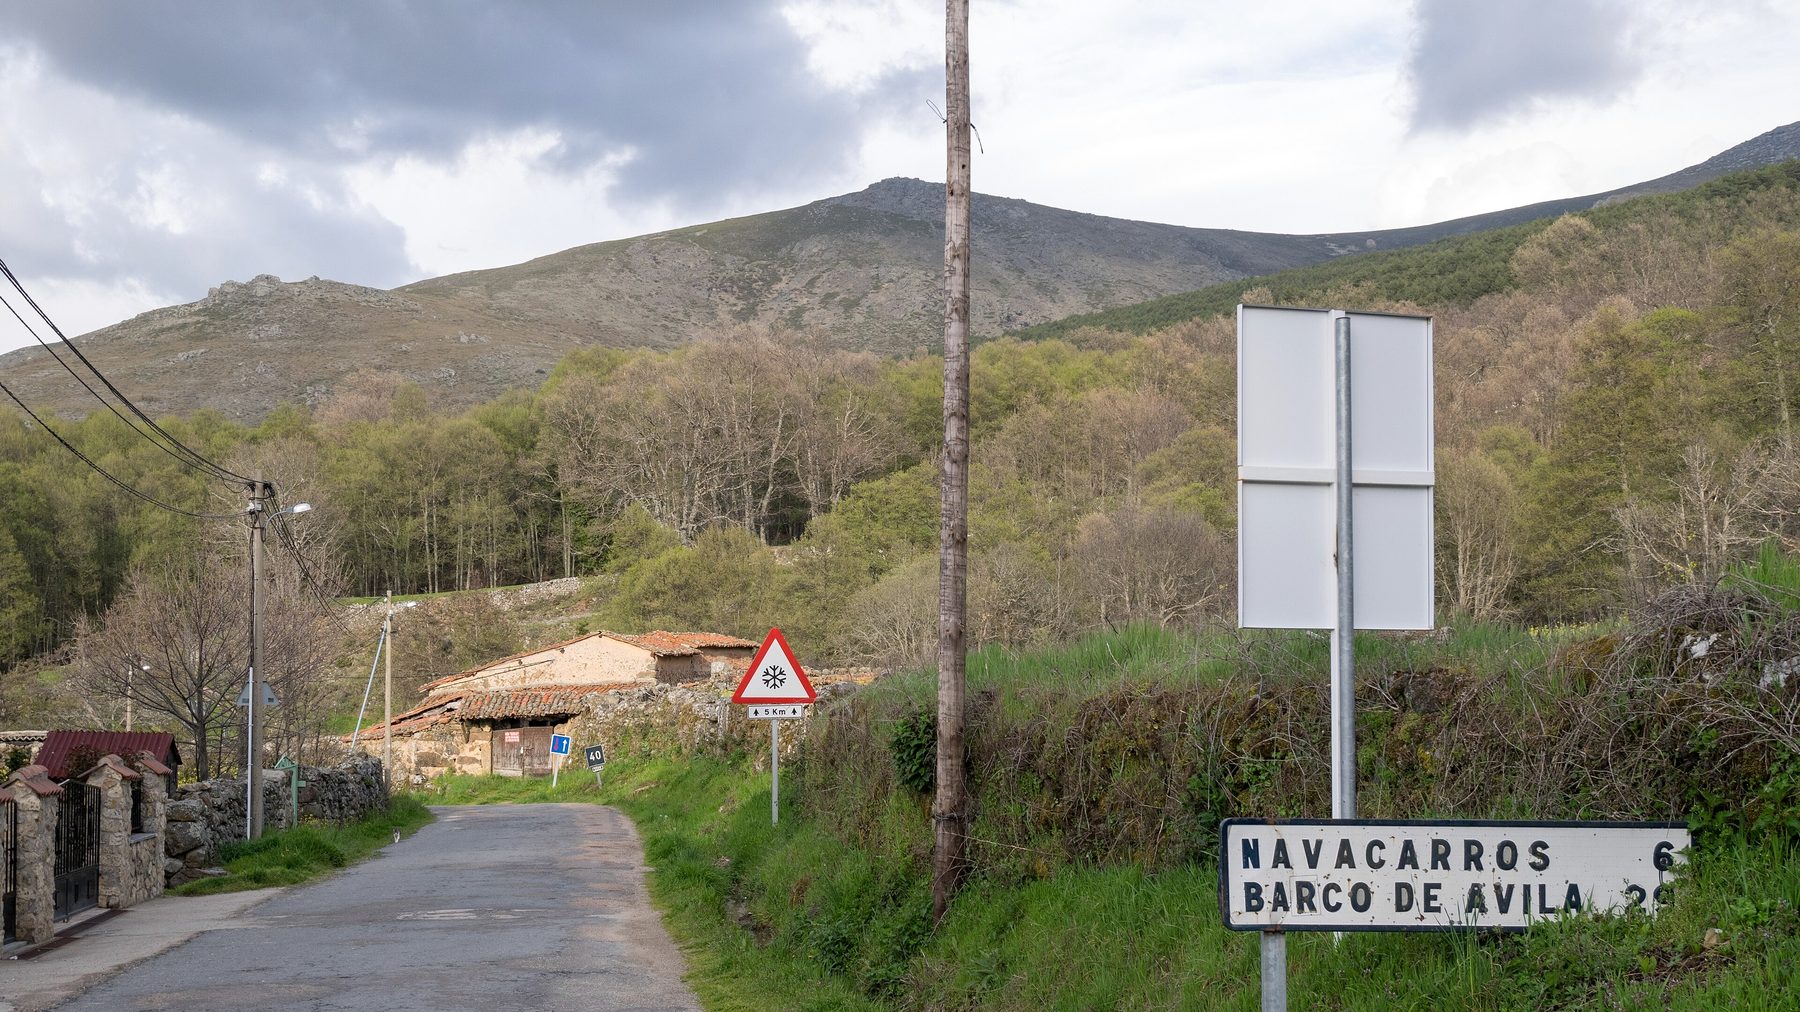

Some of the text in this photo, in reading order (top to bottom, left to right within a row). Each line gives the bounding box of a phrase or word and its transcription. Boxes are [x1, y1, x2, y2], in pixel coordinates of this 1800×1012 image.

[764, 708, 786, 716] 5 Km
[589, 750, 602, 762] 40
[1241, 838, 1675, 872] NAVACARROS 6
[1243, 881, 1372, 914] BARCO
[1394, 882, 1442, 914] DE
[1464, 882, 1583, 915] AVILA
